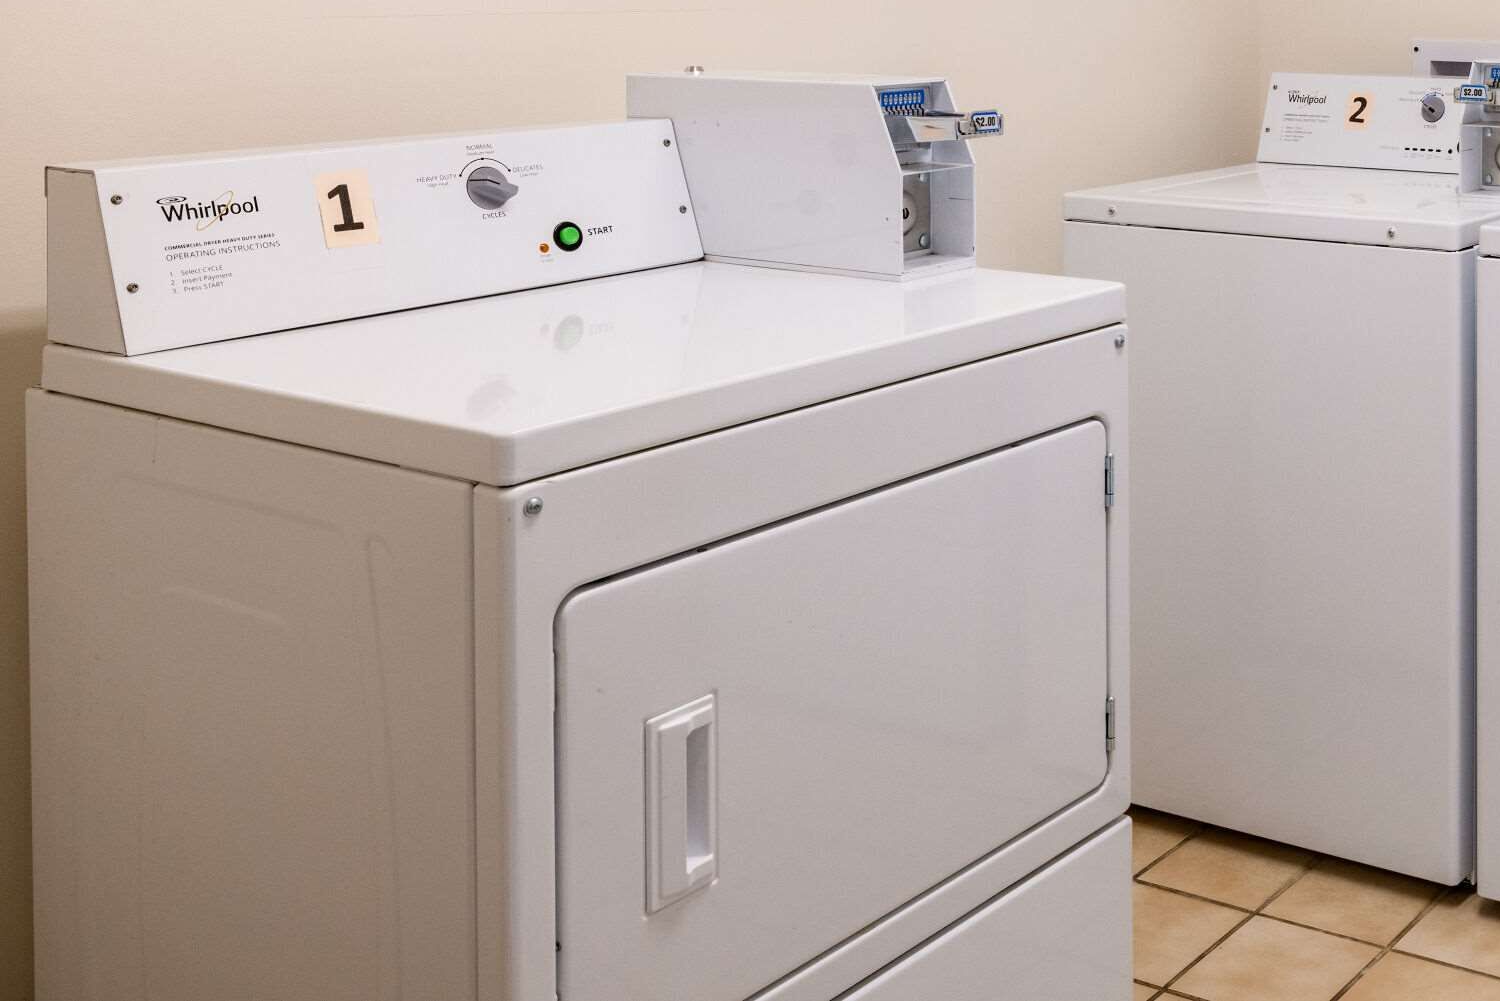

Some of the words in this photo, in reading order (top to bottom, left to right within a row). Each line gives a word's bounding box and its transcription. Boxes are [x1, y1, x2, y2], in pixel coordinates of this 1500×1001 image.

[1463, 88, 1483, 97] $2.00
[1288, 93, 1327, 105] Whirlpool
[1348, 96, 1368, 123] 2
[975, 116, 996, 127] $2.00
[161, 196, 260, 222] Whirlpool
[327, 184, 365, 232] 1
[482, 211, 507, 220] CYCLES
[587, 225, 614, 236] START
[166, 249, 217, 262] OPERATING
[218, 240, 281, 255] INSTRUCTIONS
[180, 267, 201, 276] Select
[183, 284, 202, 293] Press
